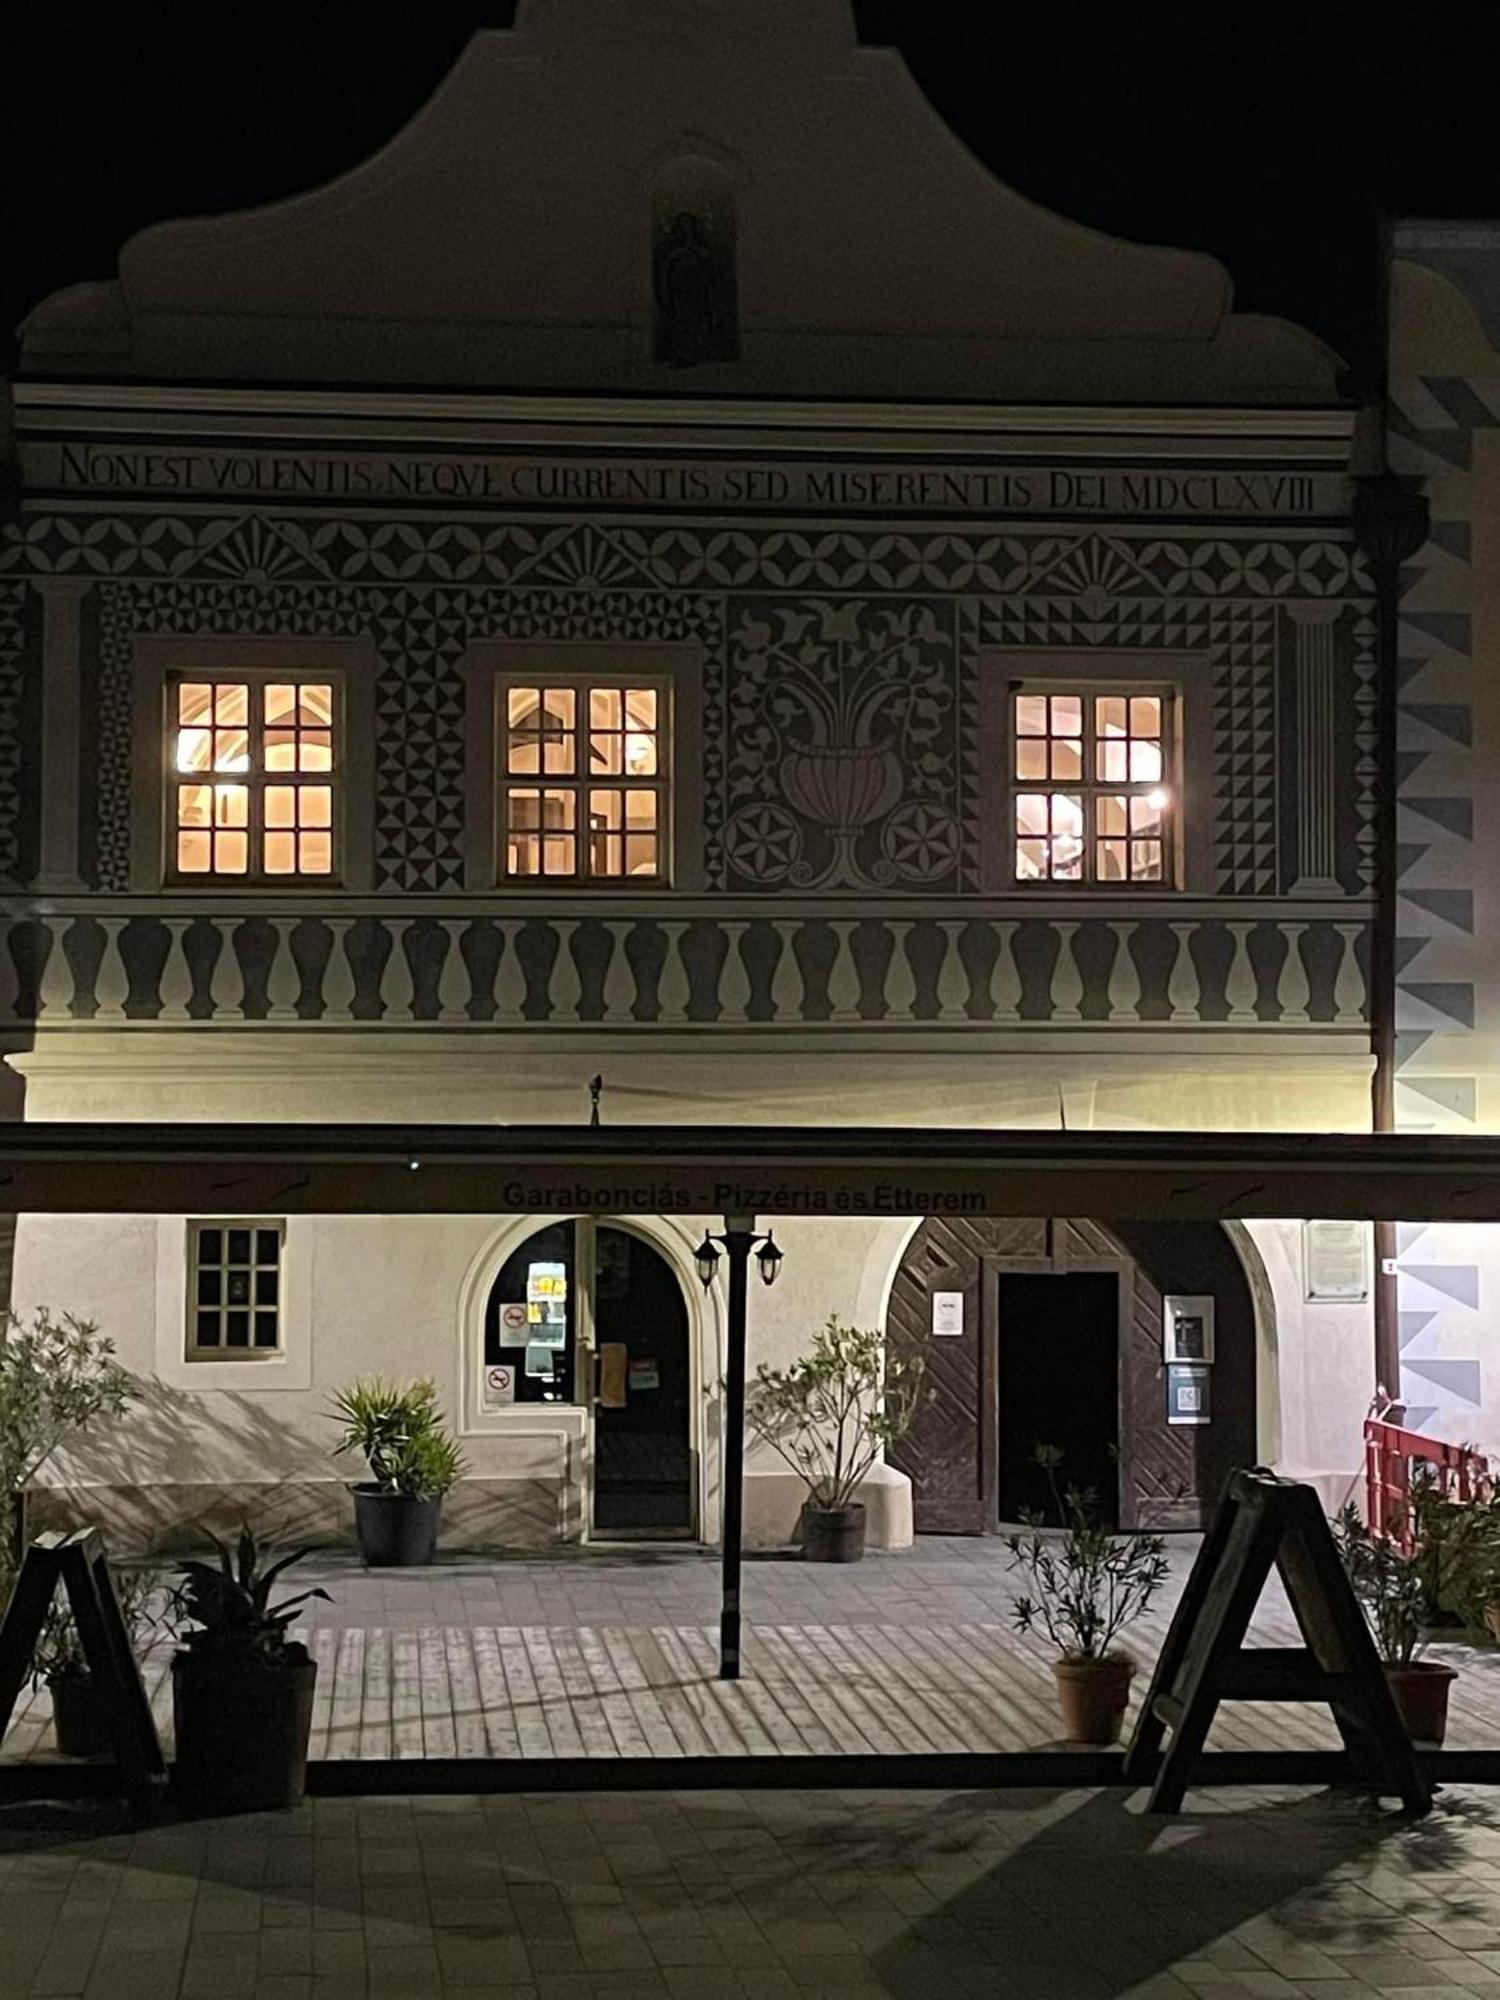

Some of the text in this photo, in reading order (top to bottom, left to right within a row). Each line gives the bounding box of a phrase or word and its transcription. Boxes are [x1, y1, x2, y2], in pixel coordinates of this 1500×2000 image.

[511, 465, 709, 501] CURRENTIS
[722, 469, 789, 502] SED
[805, 472, 1032, 507] MISERENTIS
[502, 1182, 691, 1208] Garabonciás
[714, 1182, 828, 1208] Pizzéria
[834, 1184, 867, 1210] és
[874, 1180, 986, 1211] Étterem
